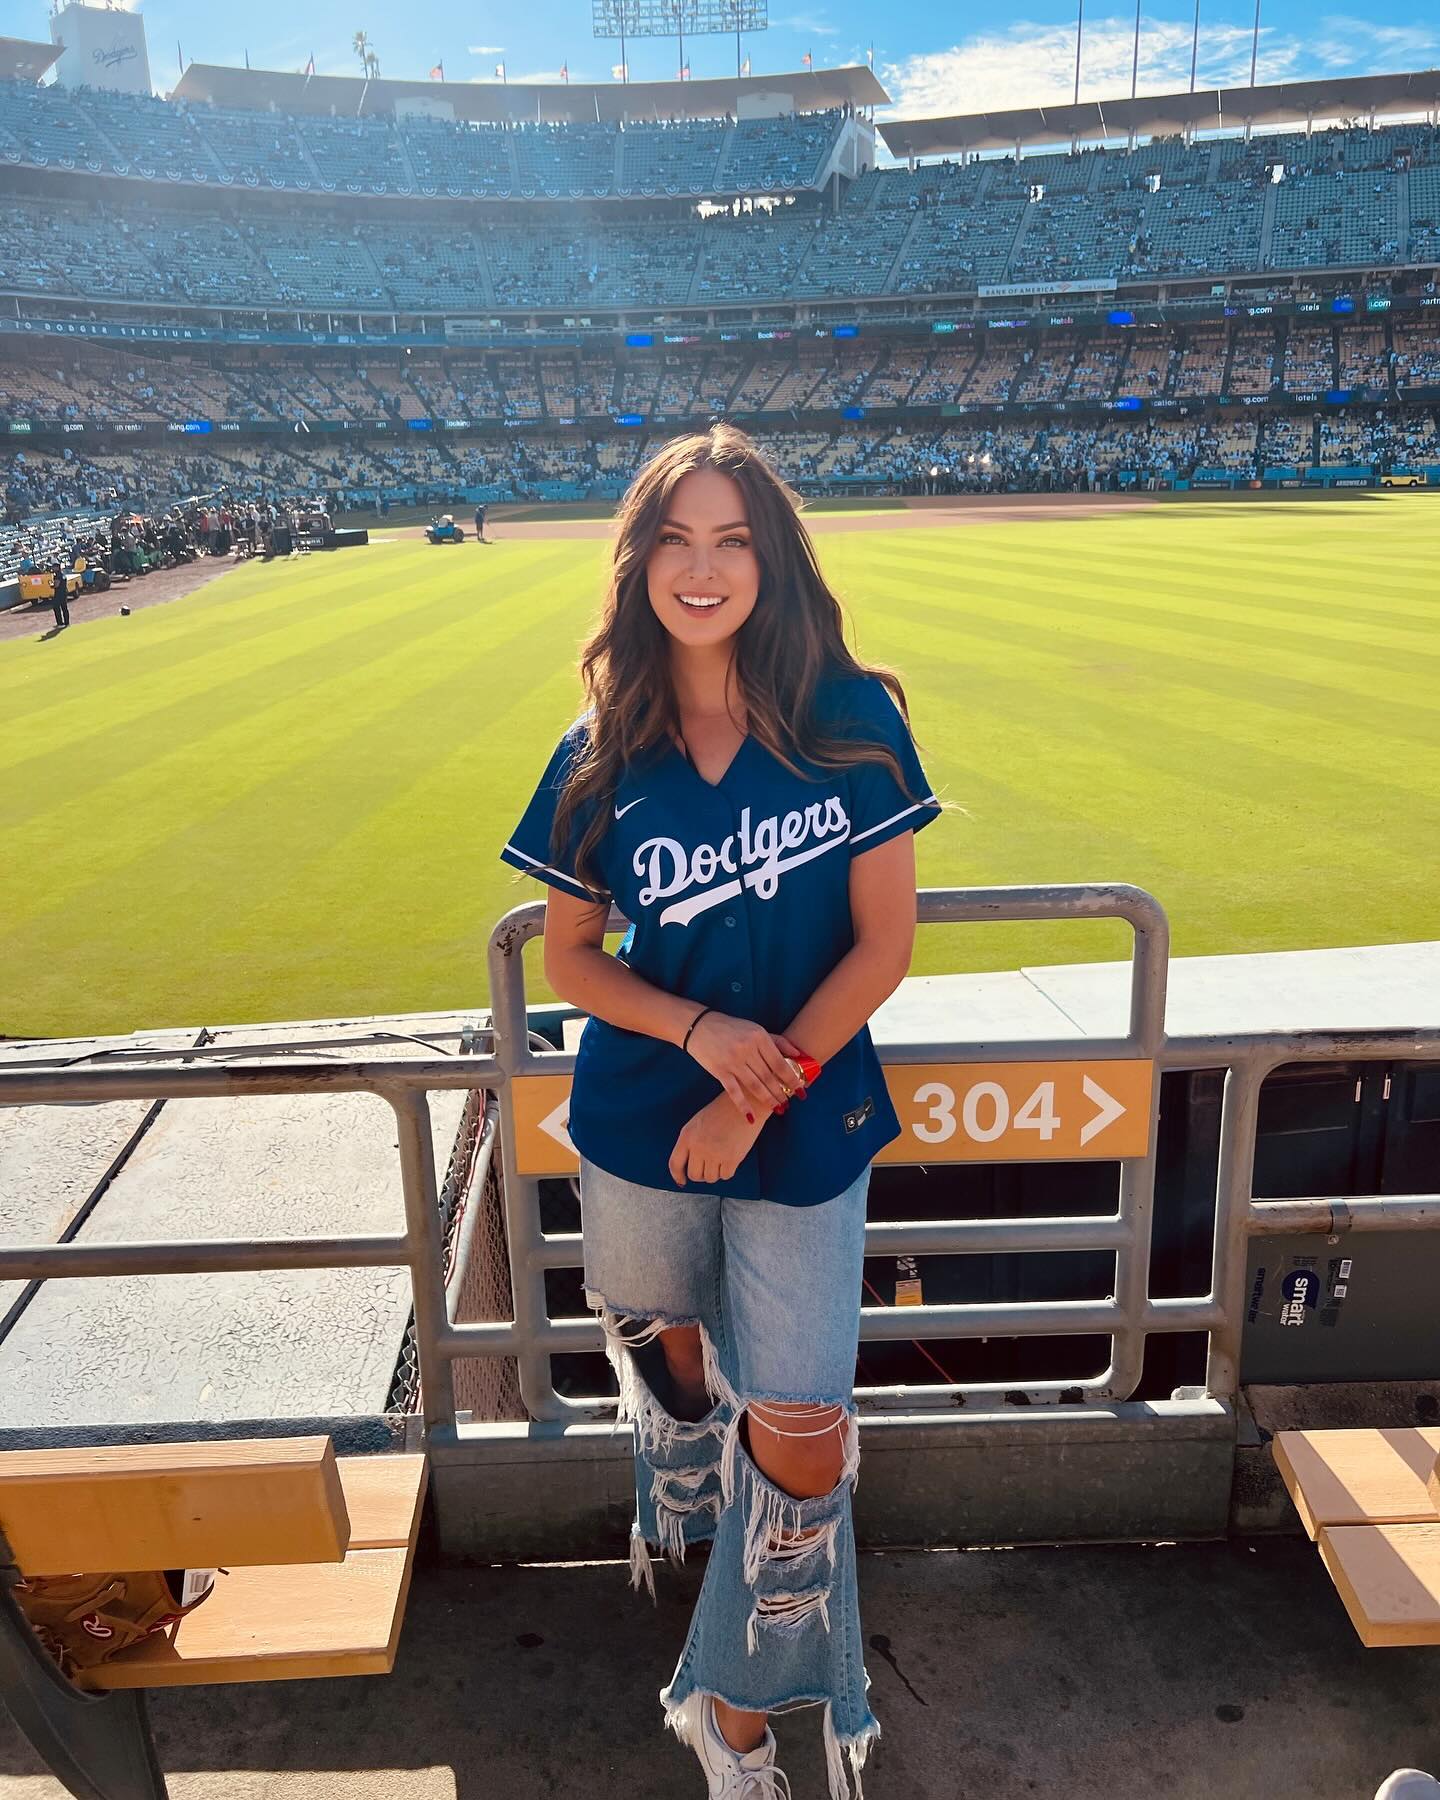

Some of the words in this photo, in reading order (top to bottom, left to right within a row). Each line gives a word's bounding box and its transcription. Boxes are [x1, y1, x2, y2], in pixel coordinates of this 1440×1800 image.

[1020, 286, 1055, 294] AMERICA
[633, 796, 850, 927] Dodgers
[911, 1081, 1061, 1144] 304
[1279, 1303, 1291, 1326] water
[1287, 1276, 1309, 1326] smart
